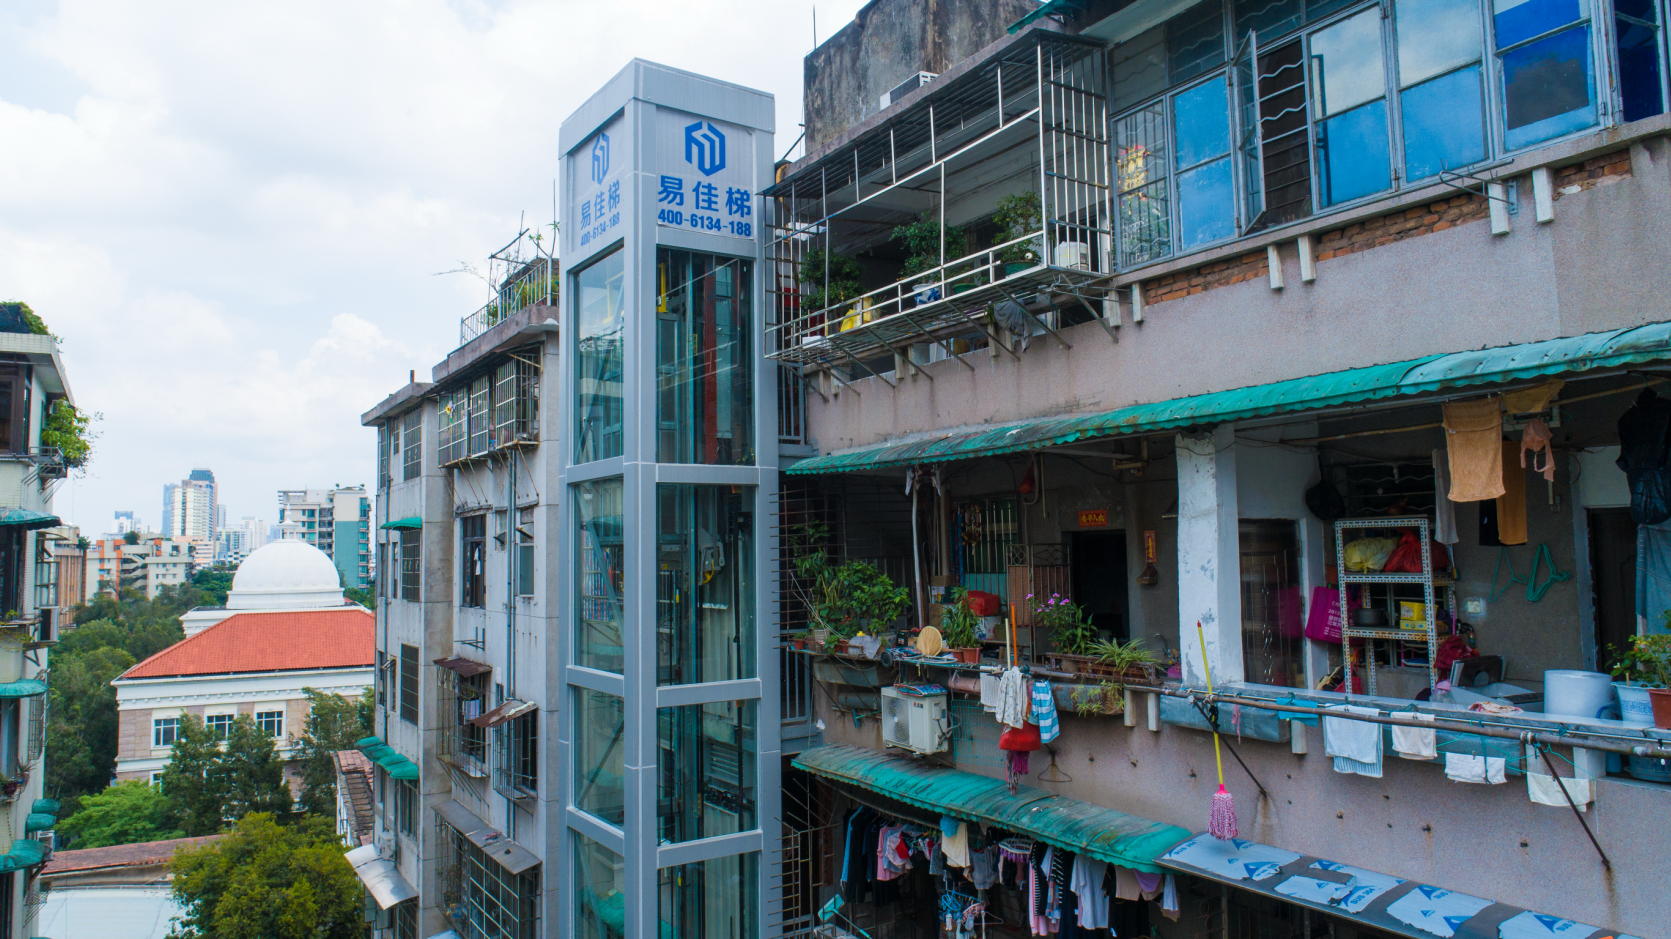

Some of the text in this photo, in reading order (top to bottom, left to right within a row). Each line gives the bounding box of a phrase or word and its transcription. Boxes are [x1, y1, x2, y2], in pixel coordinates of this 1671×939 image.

[580, 179, 620, 231] 易佳梯
[657, 174, 752, 218] 易佳梯
[580, 211, 620, 247] 400-6134-188
[657, 208, 752, 237] 400-6134-188
[1350, 895, 1366, 905] SUS
